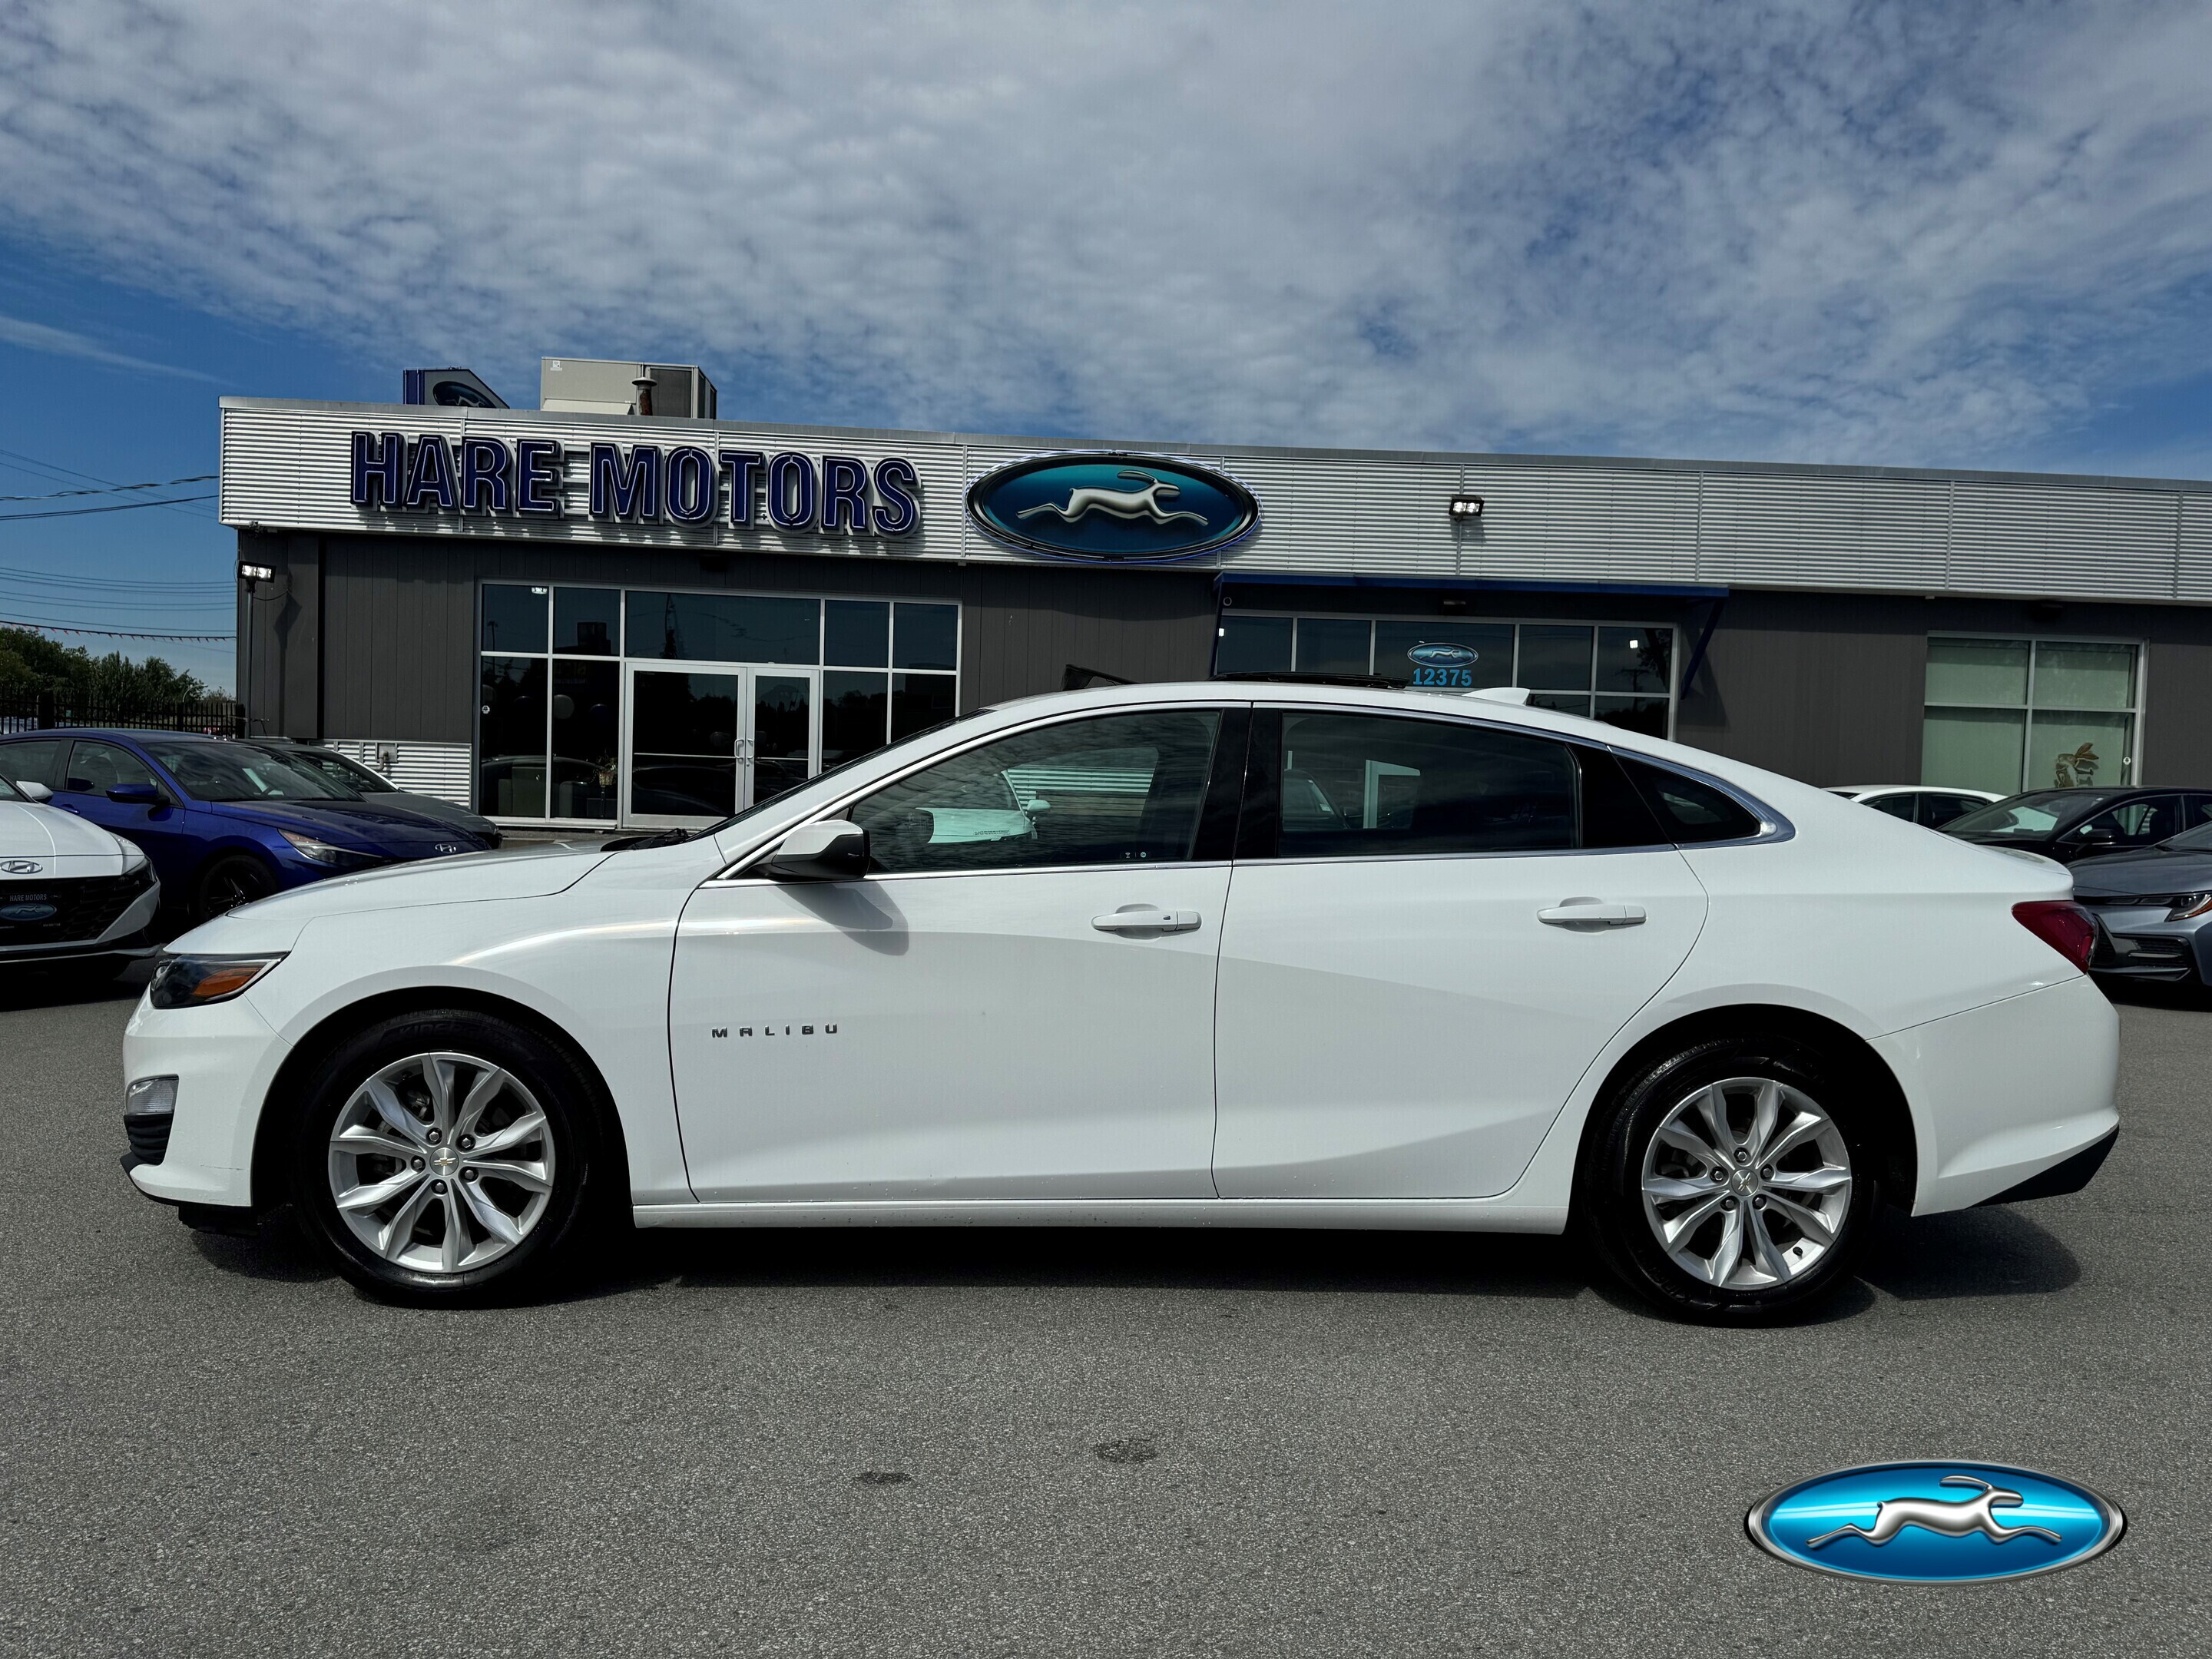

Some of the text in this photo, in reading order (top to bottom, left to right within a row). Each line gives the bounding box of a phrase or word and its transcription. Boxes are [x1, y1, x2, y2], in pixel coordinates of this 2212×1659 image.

[350, 431, 922, 537] HARE MOTORS
[1413, 667, 1472, 687] 12375
[711, 1023, 838, 1038] MALIBU
